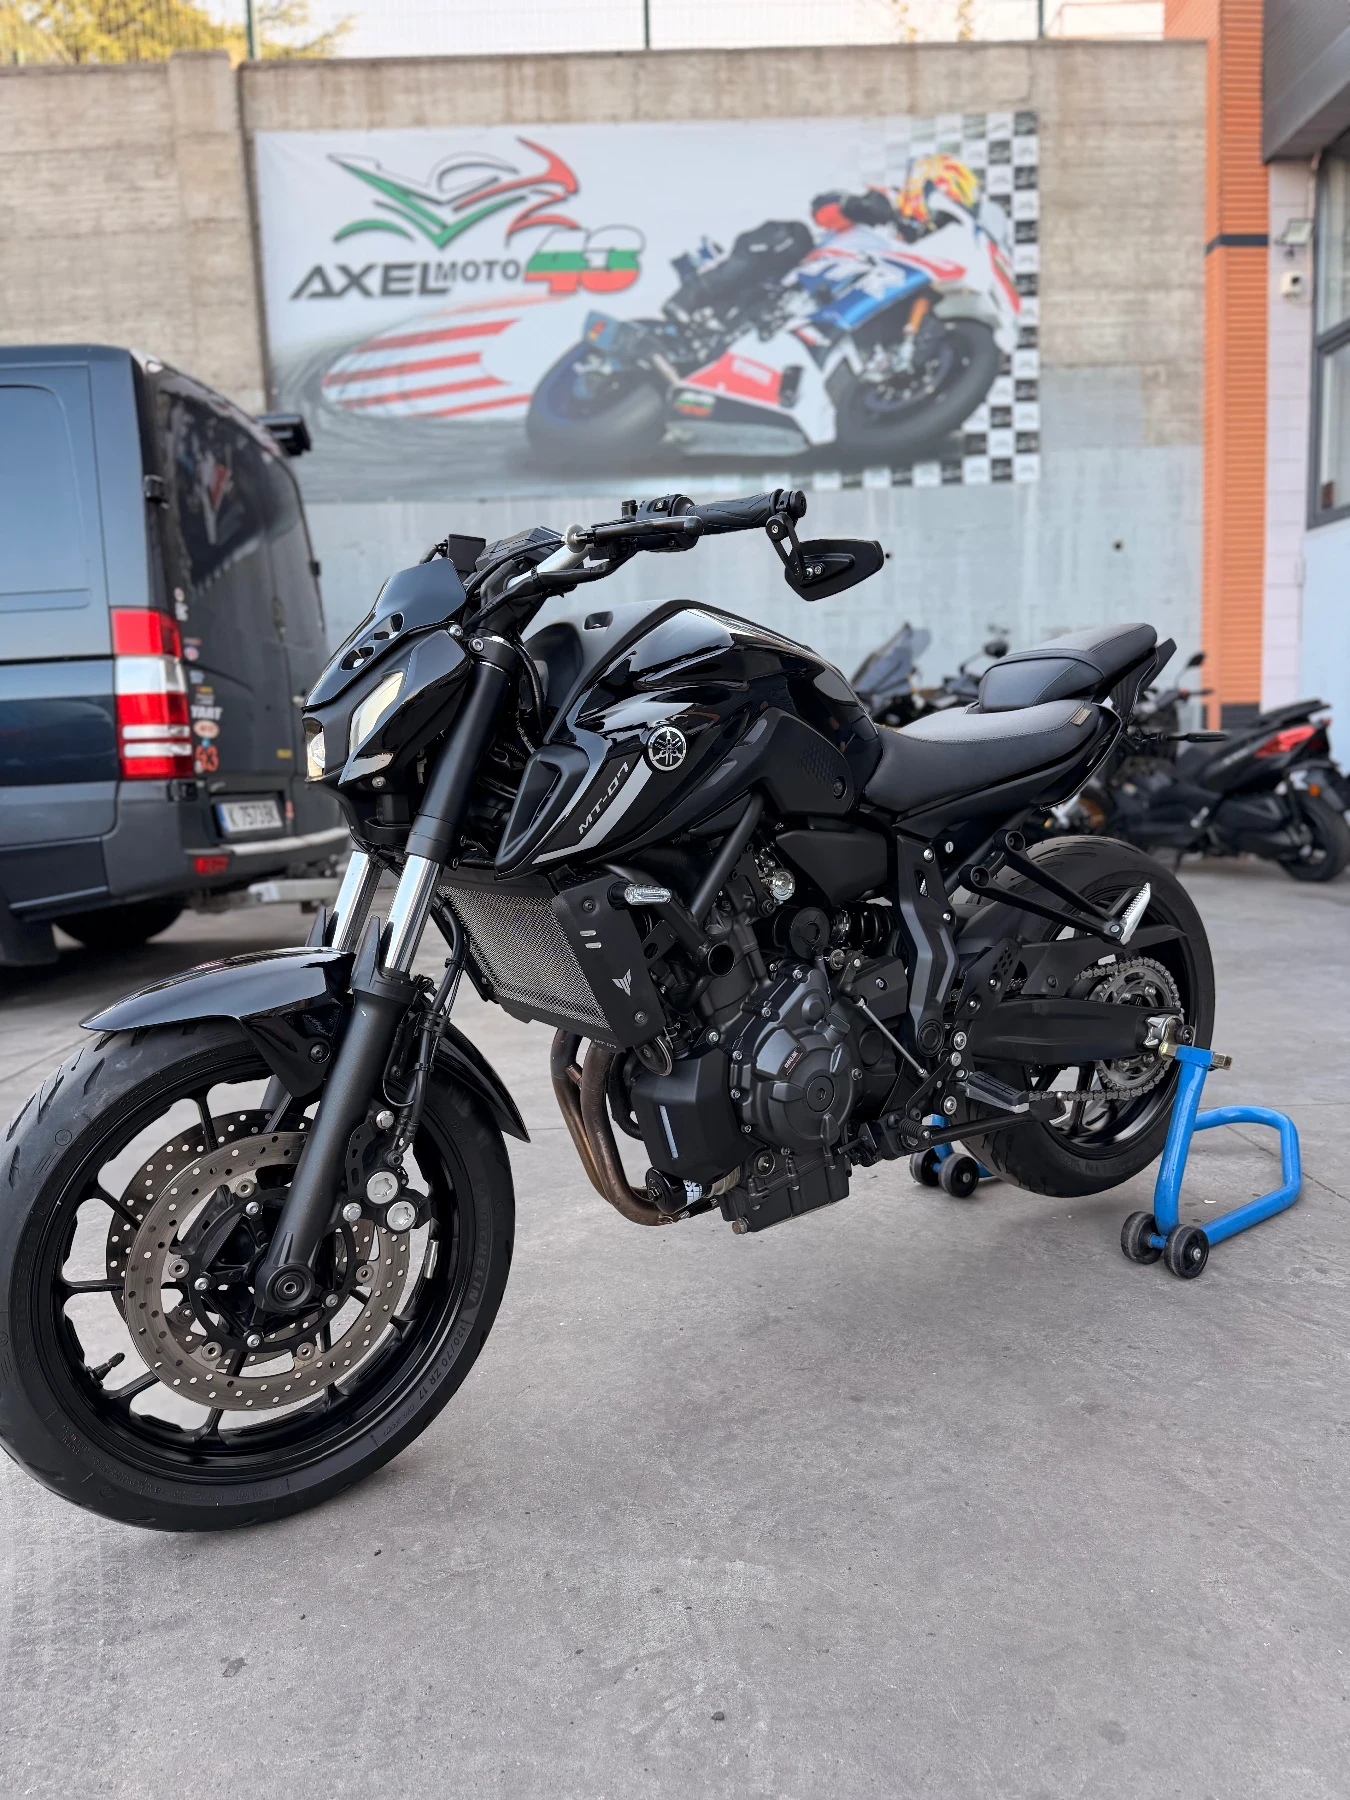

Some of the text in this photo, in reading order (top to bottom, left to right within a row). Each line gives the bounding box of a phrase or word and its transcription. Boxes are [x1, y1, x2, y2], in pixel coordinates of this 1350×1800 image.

[290, 262, 452, 300] AXEL
[435, 259, 521, 283] MOTO
[578, 761, 629, 834] MT-07
[418, 1325, 466, 1401] 120/70 ZR 17
